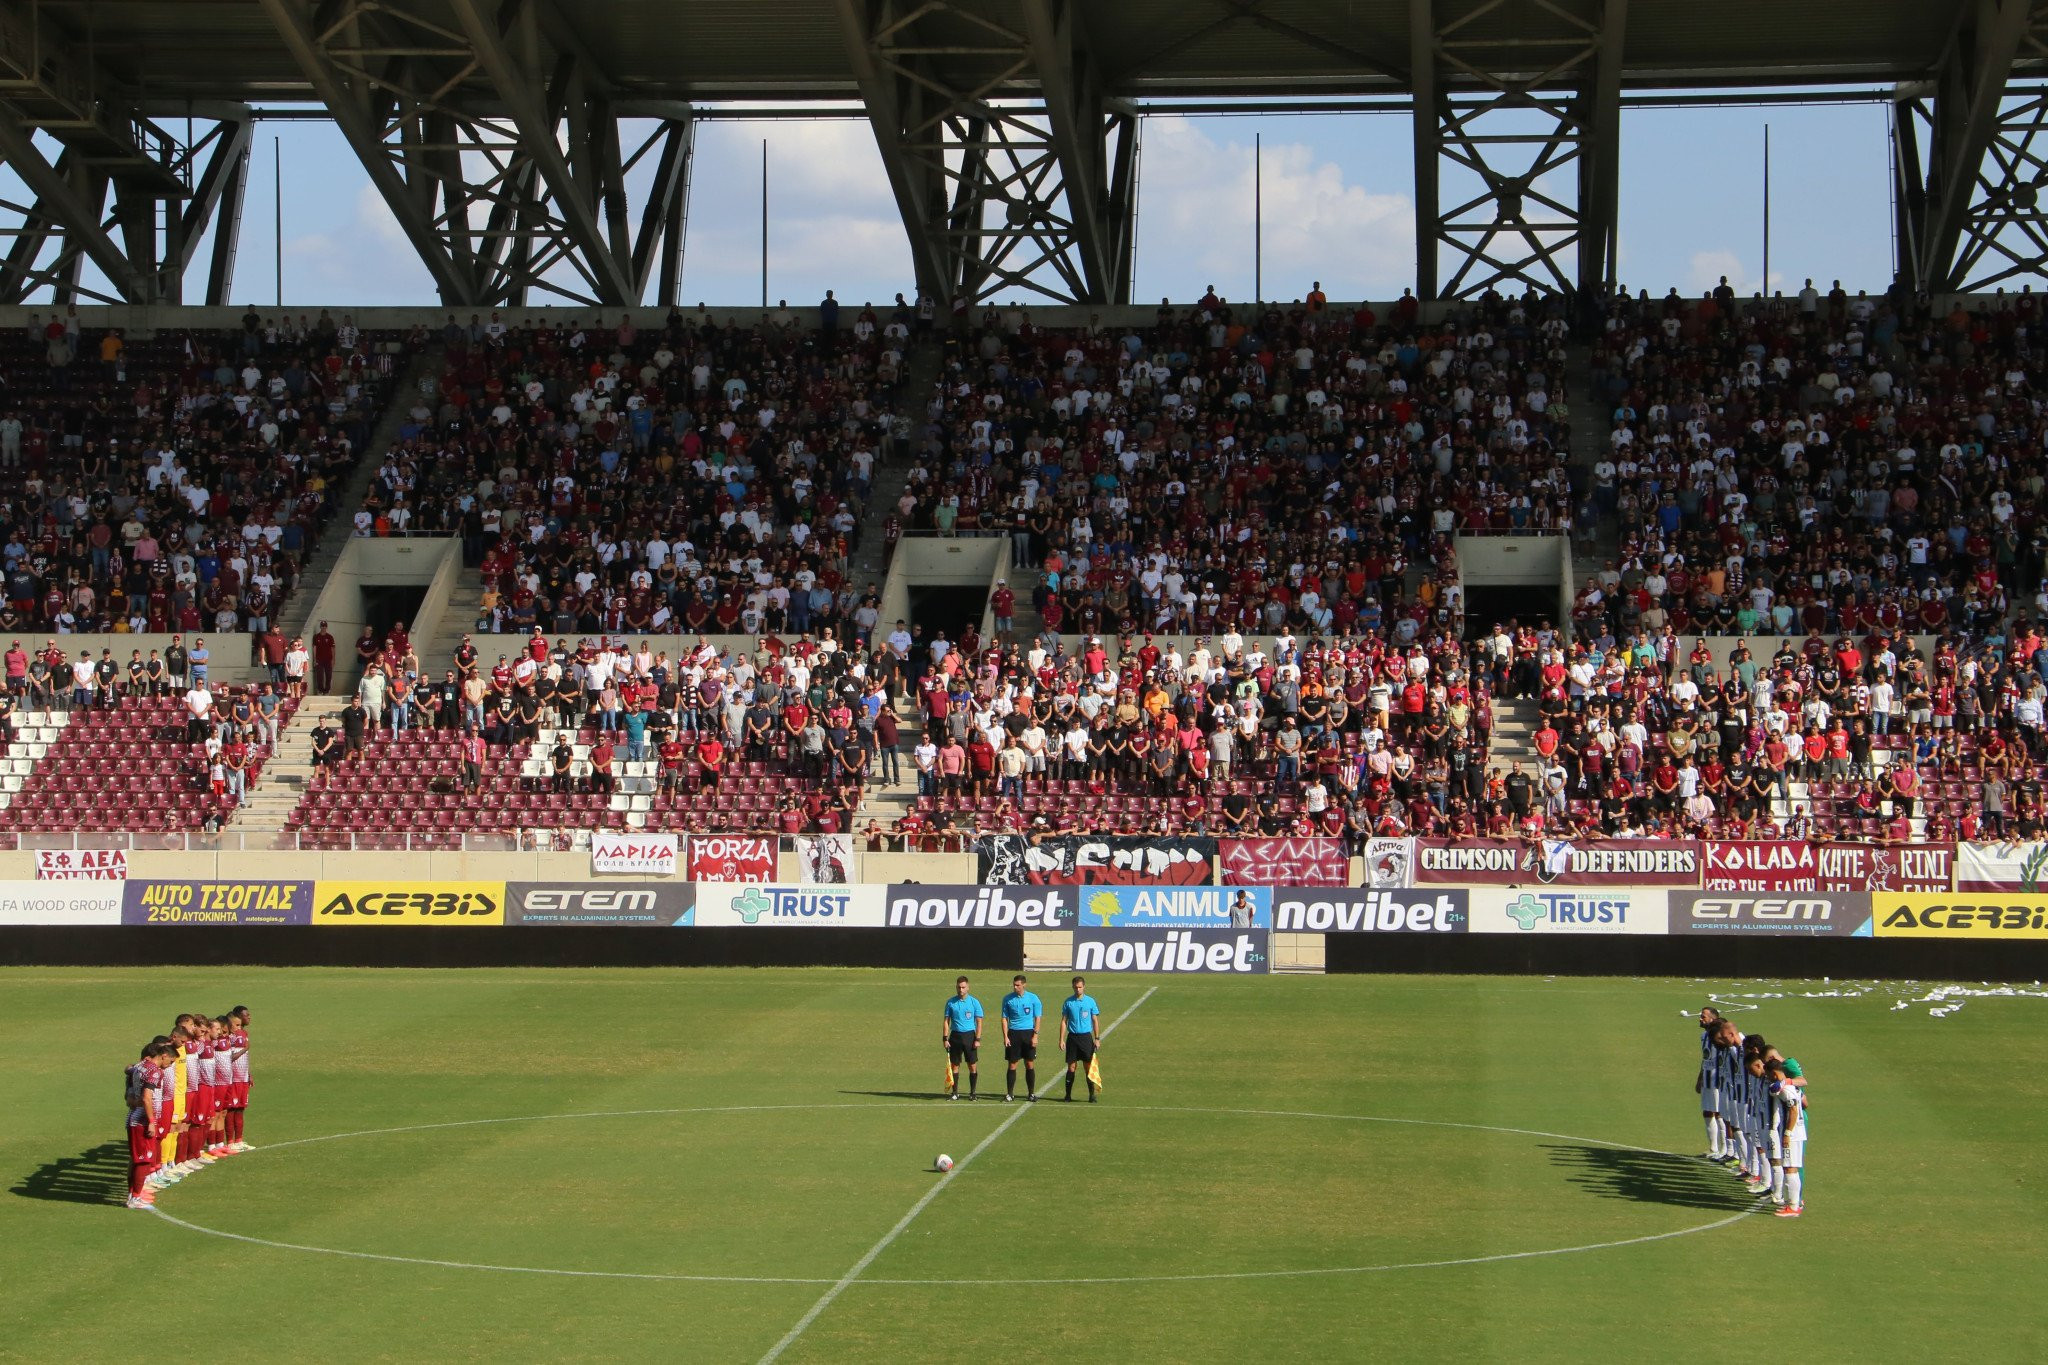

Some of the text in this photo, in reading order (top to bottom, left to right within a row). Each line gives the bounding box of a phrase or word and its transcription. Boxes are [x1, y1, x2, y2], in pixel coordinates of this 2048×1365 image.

[692, 838, 773, 866] FORZA
[1421, 848, 1695, 873] CRIMSON DEFENDERS
[1818, 849, 1865, 878] KATE
[1900, 850, 1949, 879] RINI
[23, 901, 65, 911] WOOD
[70, 901, 117, 911] GROUP
[141, 885, 297, 910] AUTO ΤΣΟΓΙΑΣ
[524, 890, 657, 910] ETEM
[764, 888, 850, 916] TRUST
[889, 888, 1064, 927] novibet
[1276, 892, 1454, 931] novibet
[1539, 894, 1630, 923] TRUST
[1692, 899, 1832, 919] ETEM
[148, 906, 181, 922] 250
[182, 911, 237, 922] ΑΥΤΟΚΙΝΗΤΑ
[1076, 931, 1254, 971] novibet
